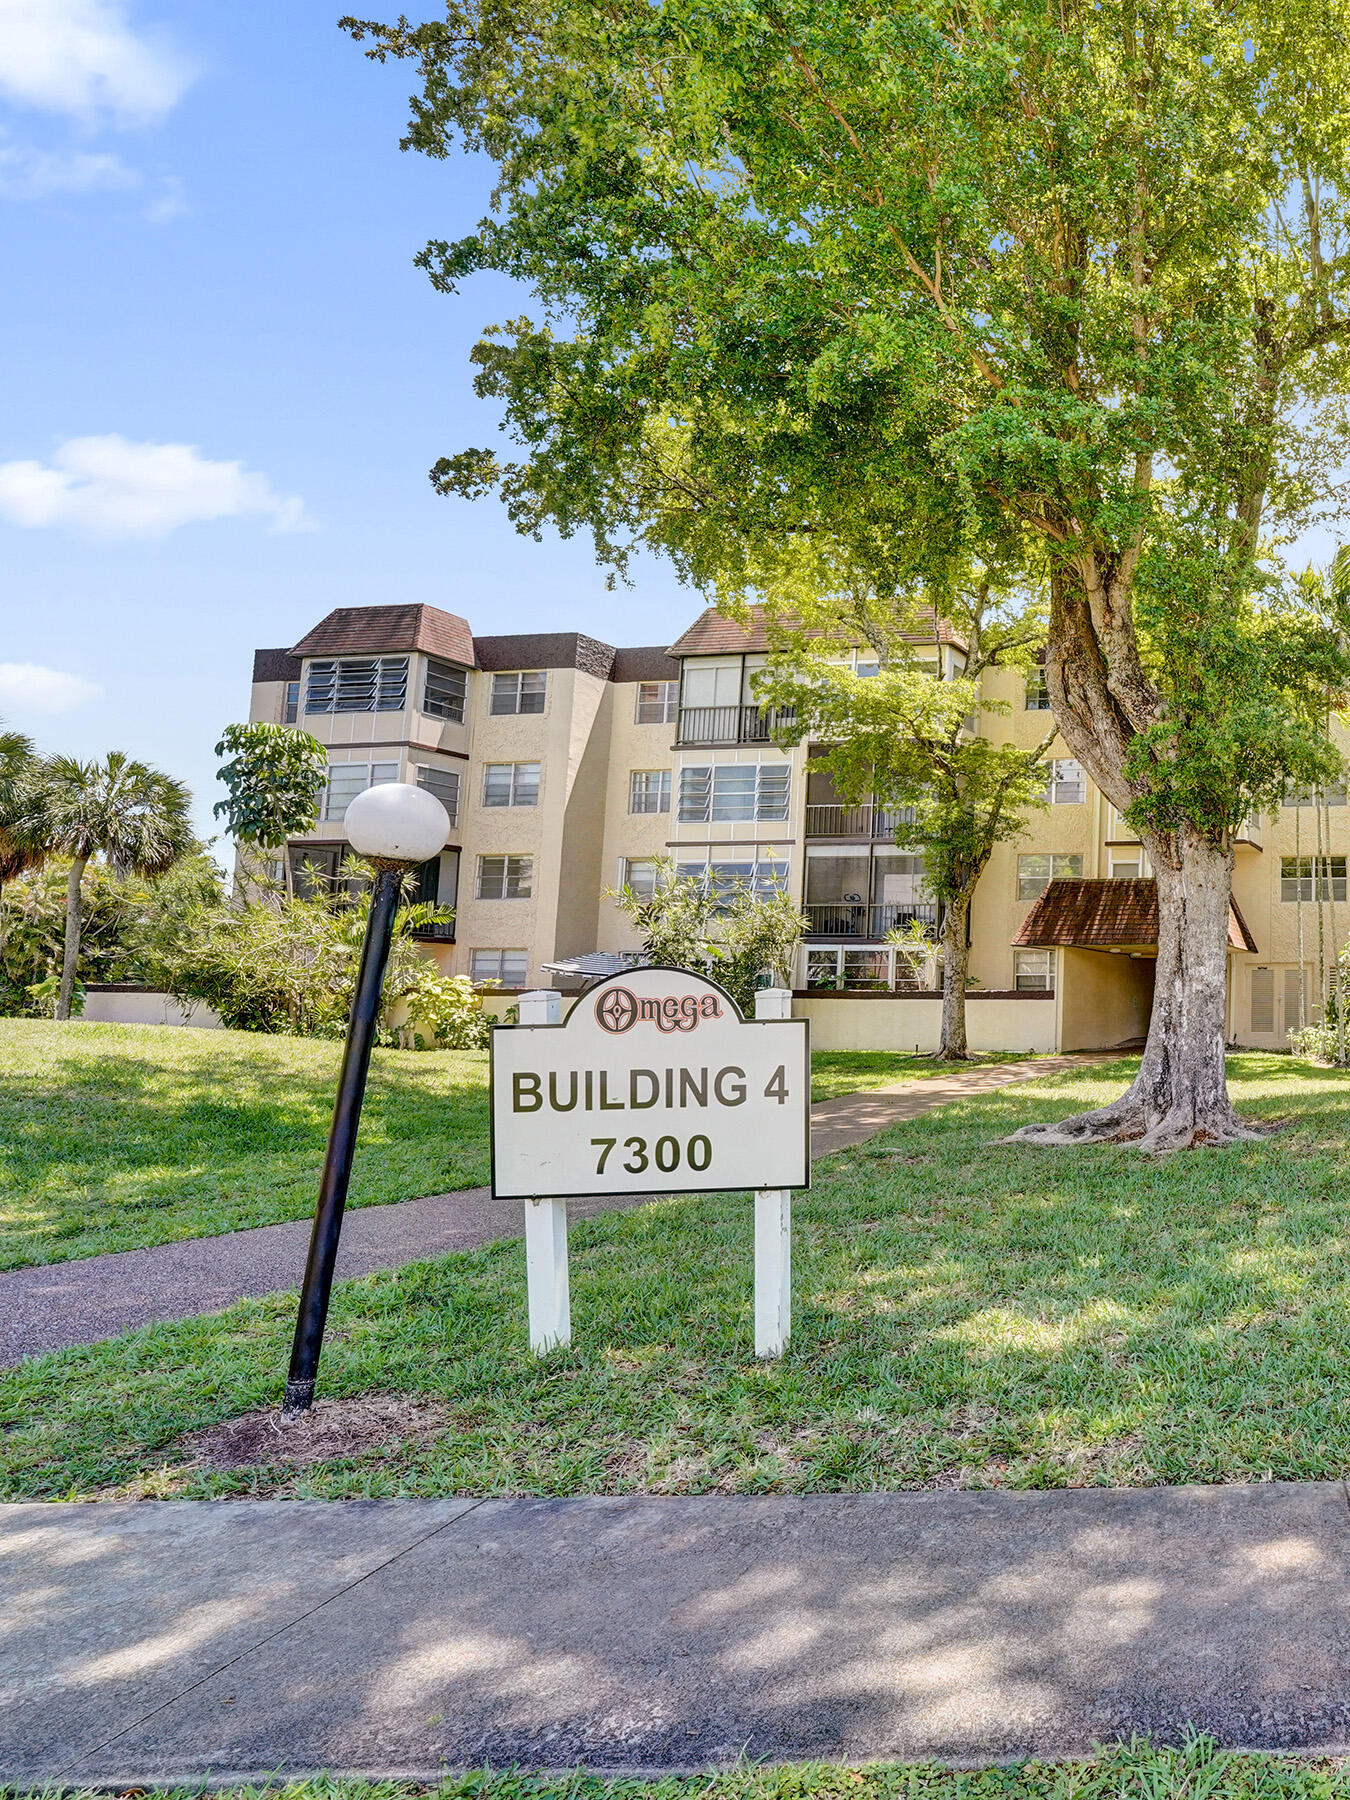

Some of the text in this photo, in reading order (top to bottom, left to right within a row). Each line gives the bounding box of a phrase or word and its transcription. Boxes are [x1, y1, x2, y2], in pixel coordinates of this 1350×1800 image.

[594, 986, 724, 1035] Omega
[512, 1065, 789, 1113] BUILDING 4
[590, 1134, 713, 1175] 7300
